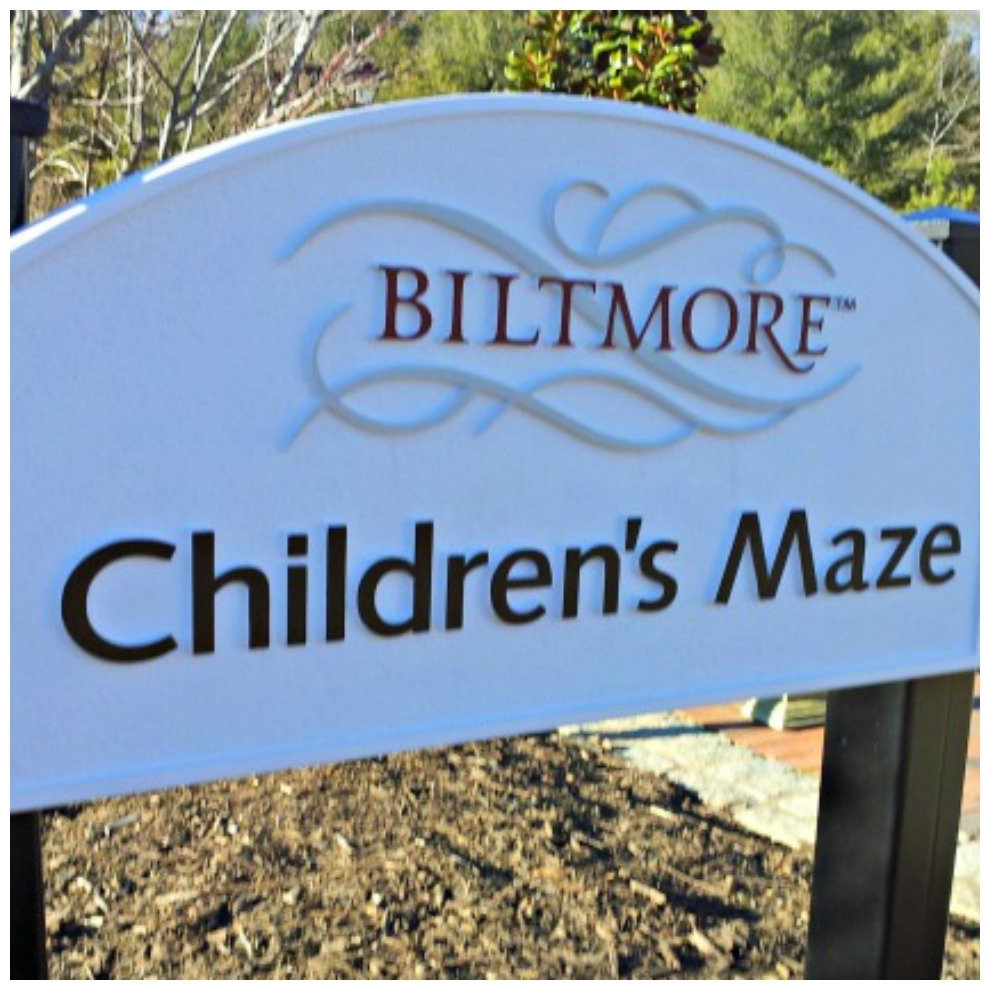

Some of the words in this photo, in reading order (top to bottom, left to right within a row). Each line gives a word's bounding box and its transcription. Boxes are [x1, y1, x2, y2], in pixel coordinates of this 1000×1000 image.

[378, 264, 831, 374] BILTMORE
[61, 516, 678, 663] Children's
[715, 509, 962, 604] Maze
